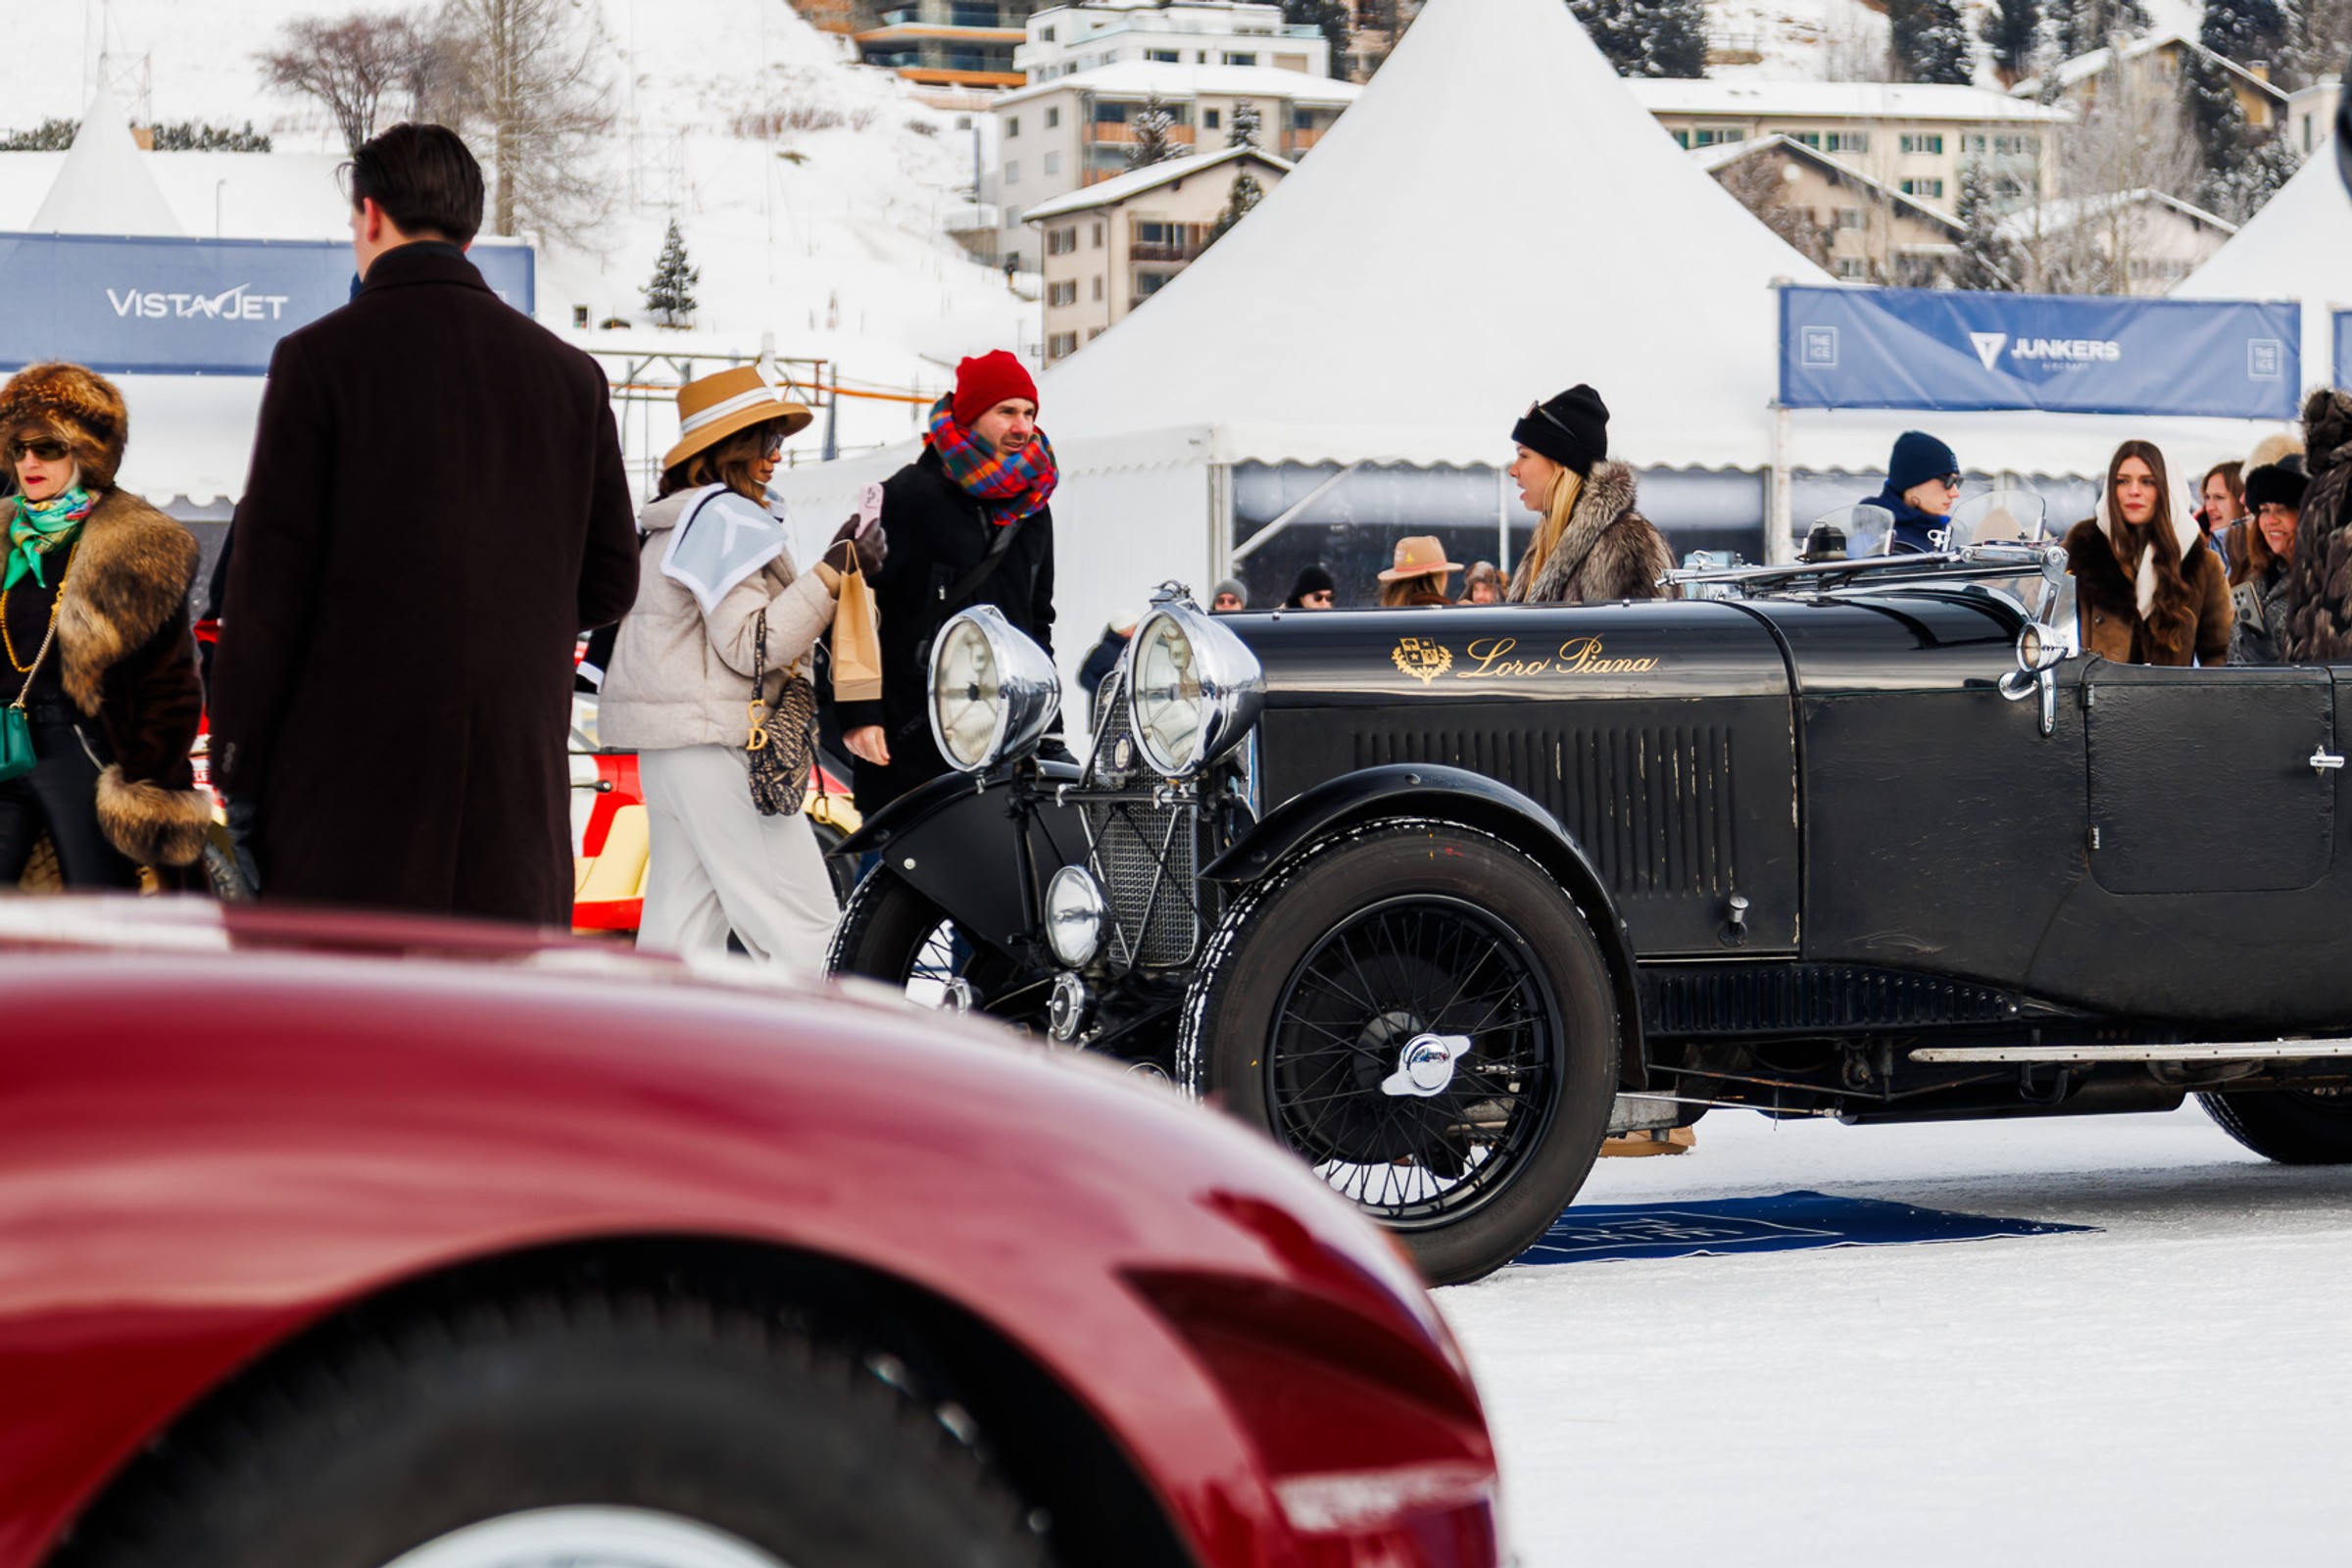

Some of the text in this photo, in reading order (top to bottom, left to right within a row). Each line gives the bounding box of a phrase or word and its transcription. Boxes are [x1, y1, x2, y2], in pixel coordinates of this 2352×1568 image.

[106, 284, 288, 320] VISTAJET
[2011, 337, 2121, 362] JUNKERS
[1457, 633, 1659, 678] Loro Piana
